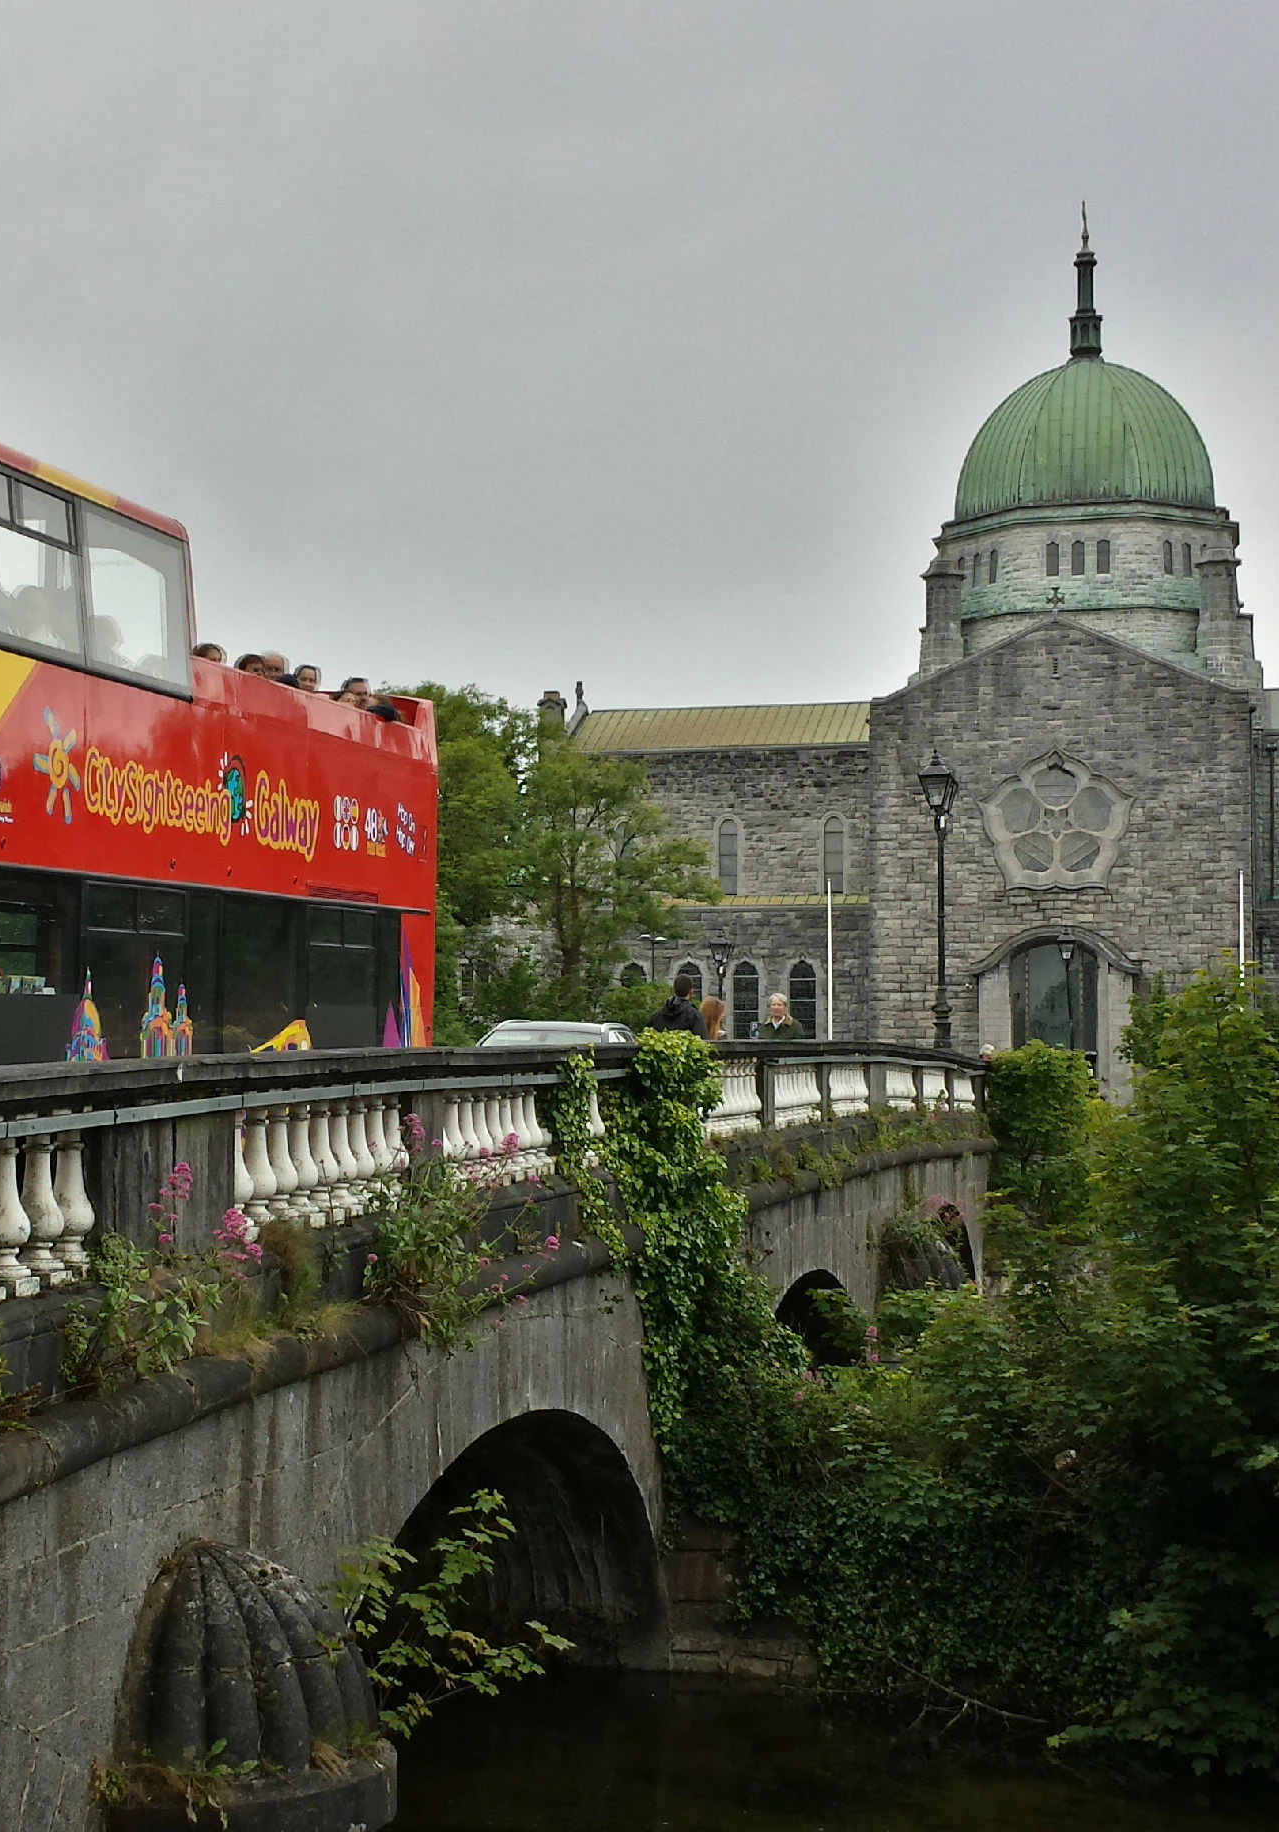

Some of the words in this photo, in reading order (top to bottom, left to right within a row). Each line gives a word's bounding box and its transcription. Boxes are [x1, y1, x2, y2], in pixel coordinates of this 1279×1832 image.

[254, 769, 320, 863] Galway
[364, 807, 378, 843] 48
[397, 801, 409, 827] Hop
